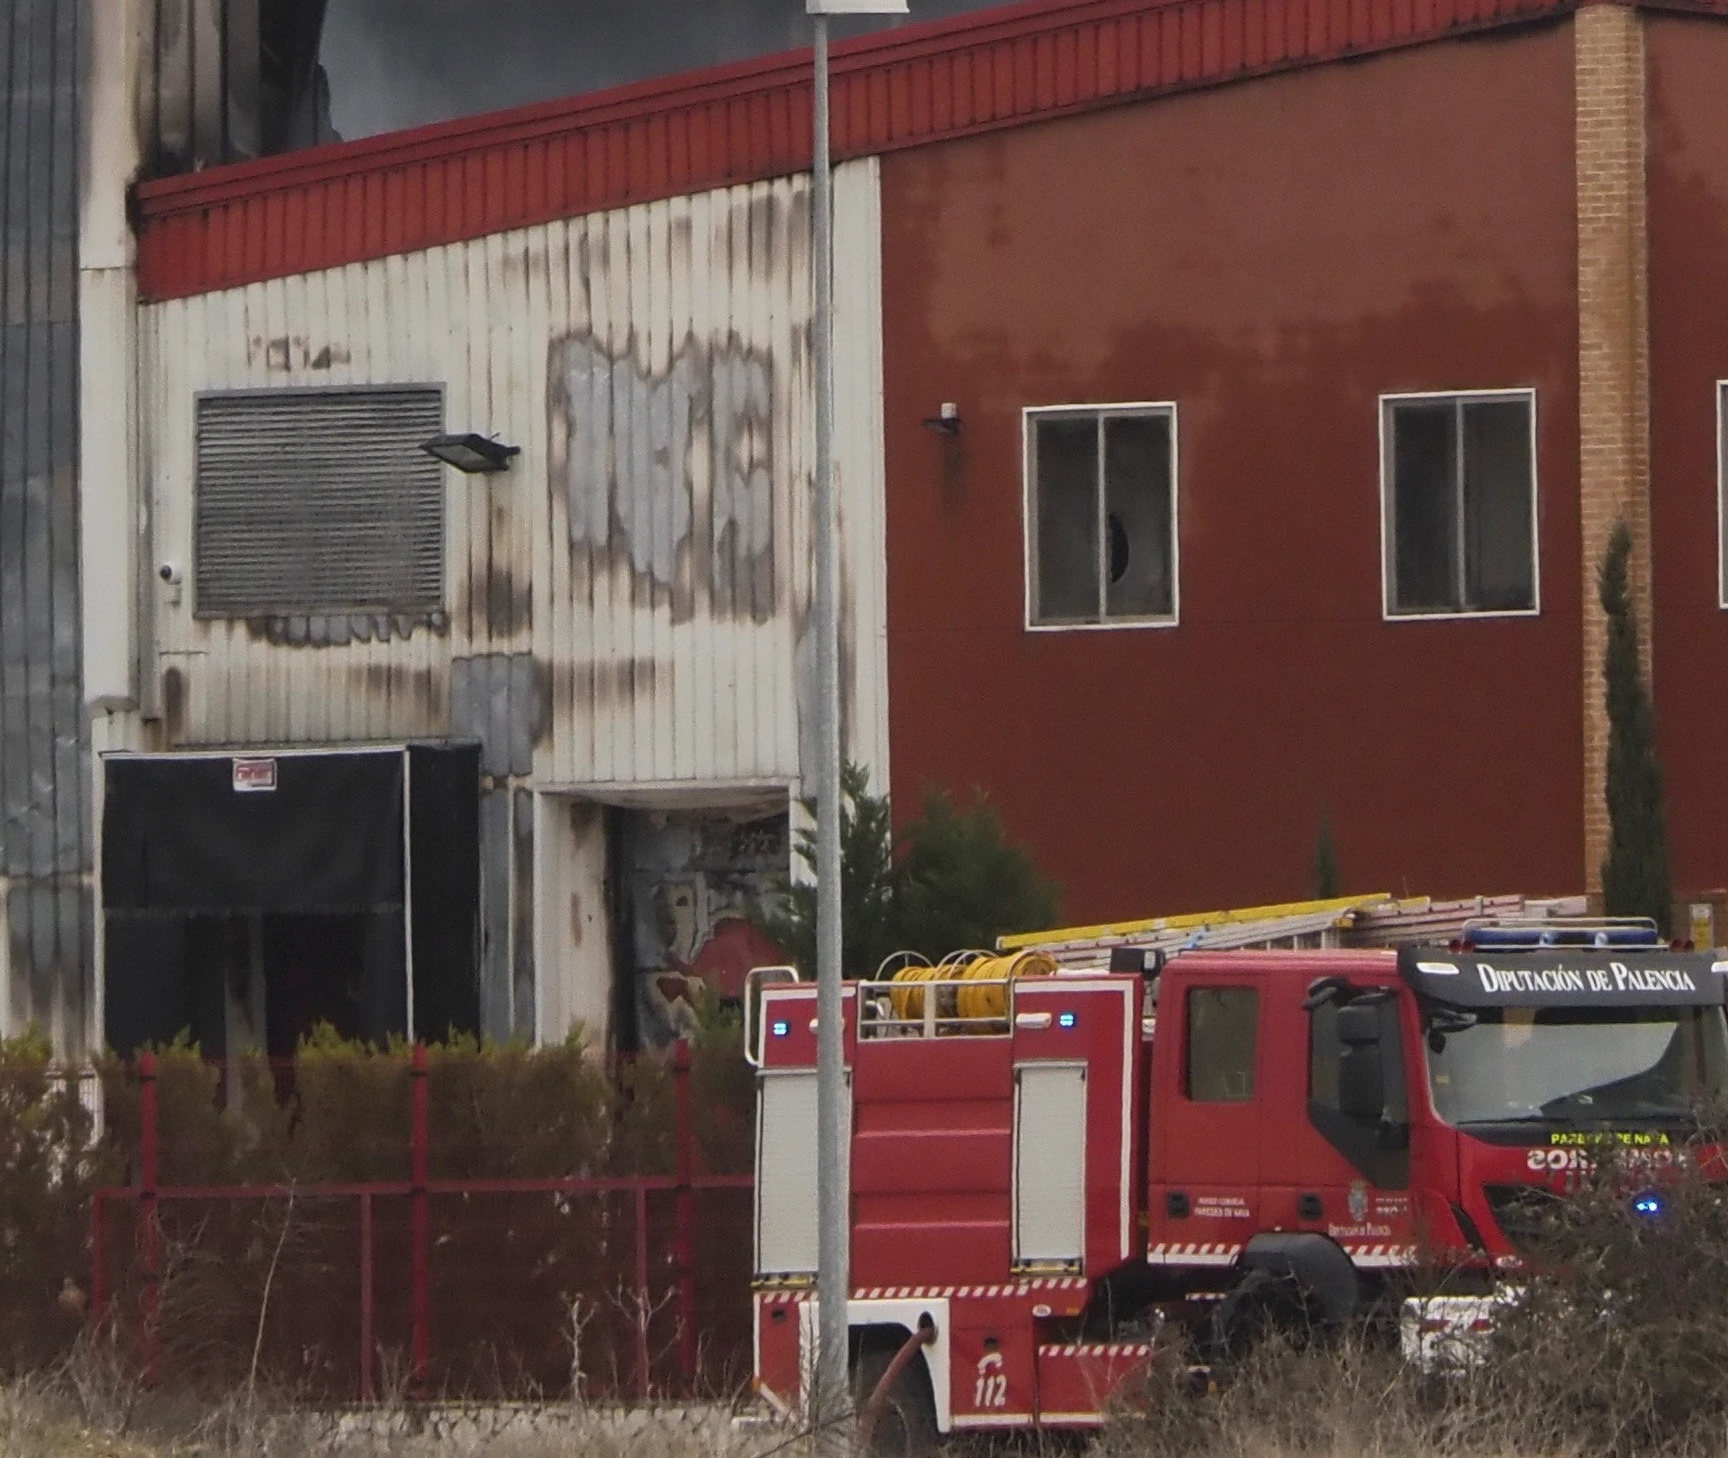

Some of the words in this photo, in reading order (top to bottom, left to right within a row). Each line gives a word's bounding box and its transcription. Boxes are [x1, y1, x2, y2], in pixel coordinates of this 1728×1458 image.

[1476, 963, 1585, 992] DIPUTACIÓN
[1586, 970, 1613, 991] DE
[1610, 962, 1696, 991] PALENCIA
[975, 1374, 1007, 1408] 112
